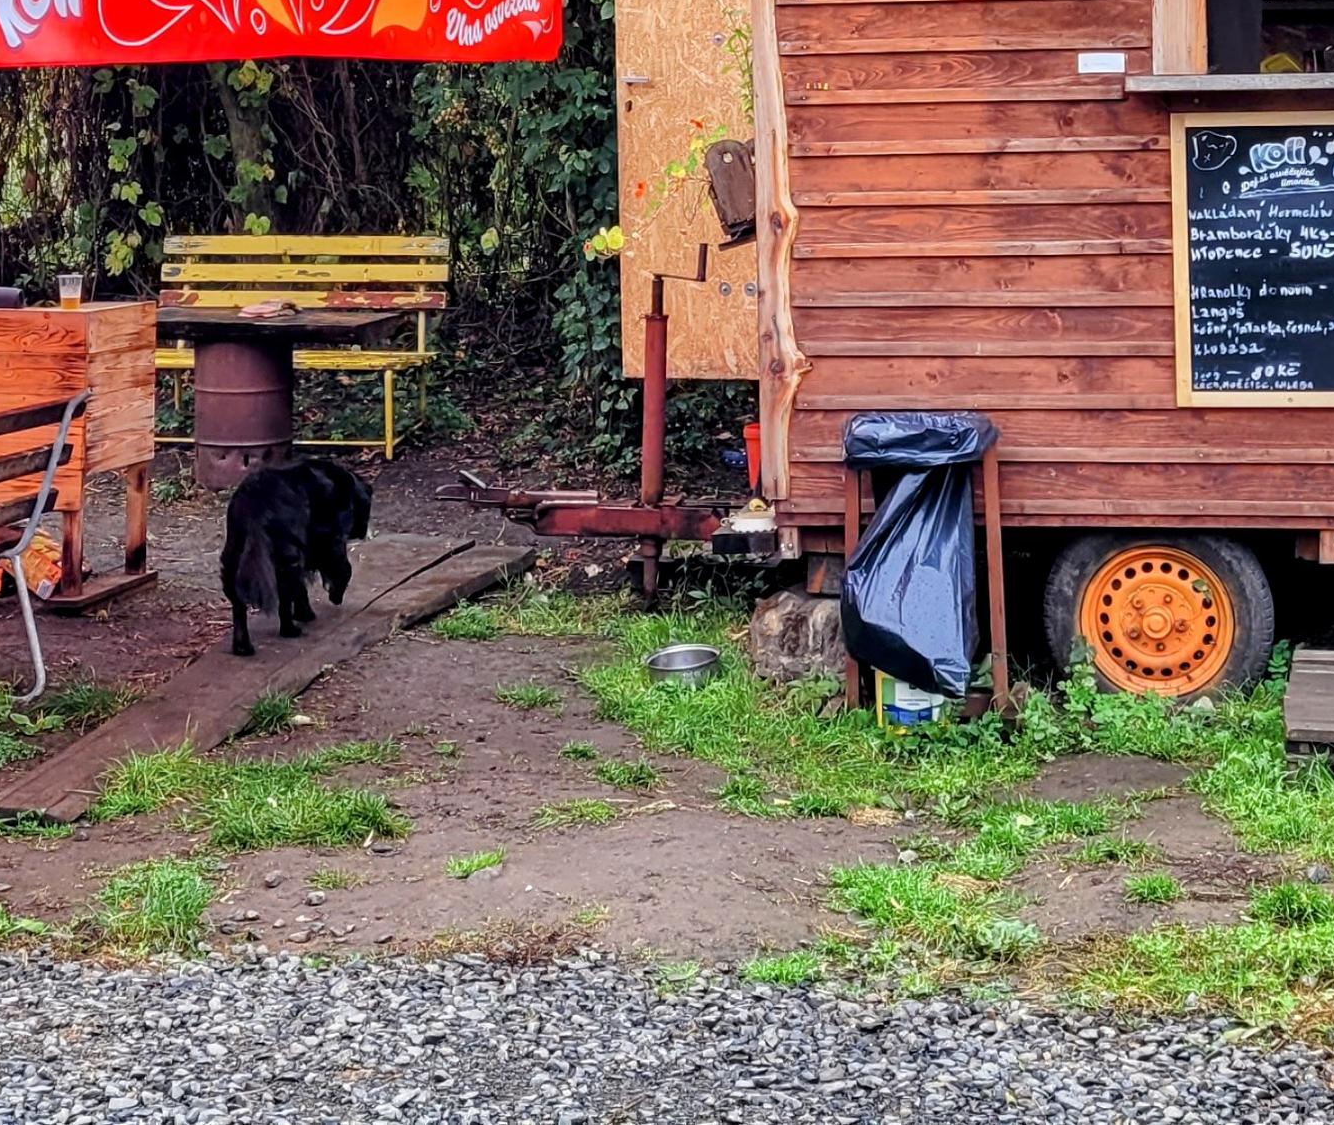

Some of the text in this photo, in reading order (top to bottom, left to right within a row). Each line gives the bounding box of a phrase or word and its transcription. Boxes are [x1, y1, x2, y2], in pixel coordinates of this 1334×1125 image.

[445, 6, 484, 47] Vlna
[1249, 136, 1307, 173] Koli
[1192, 301, 1245, 322] Langoš
